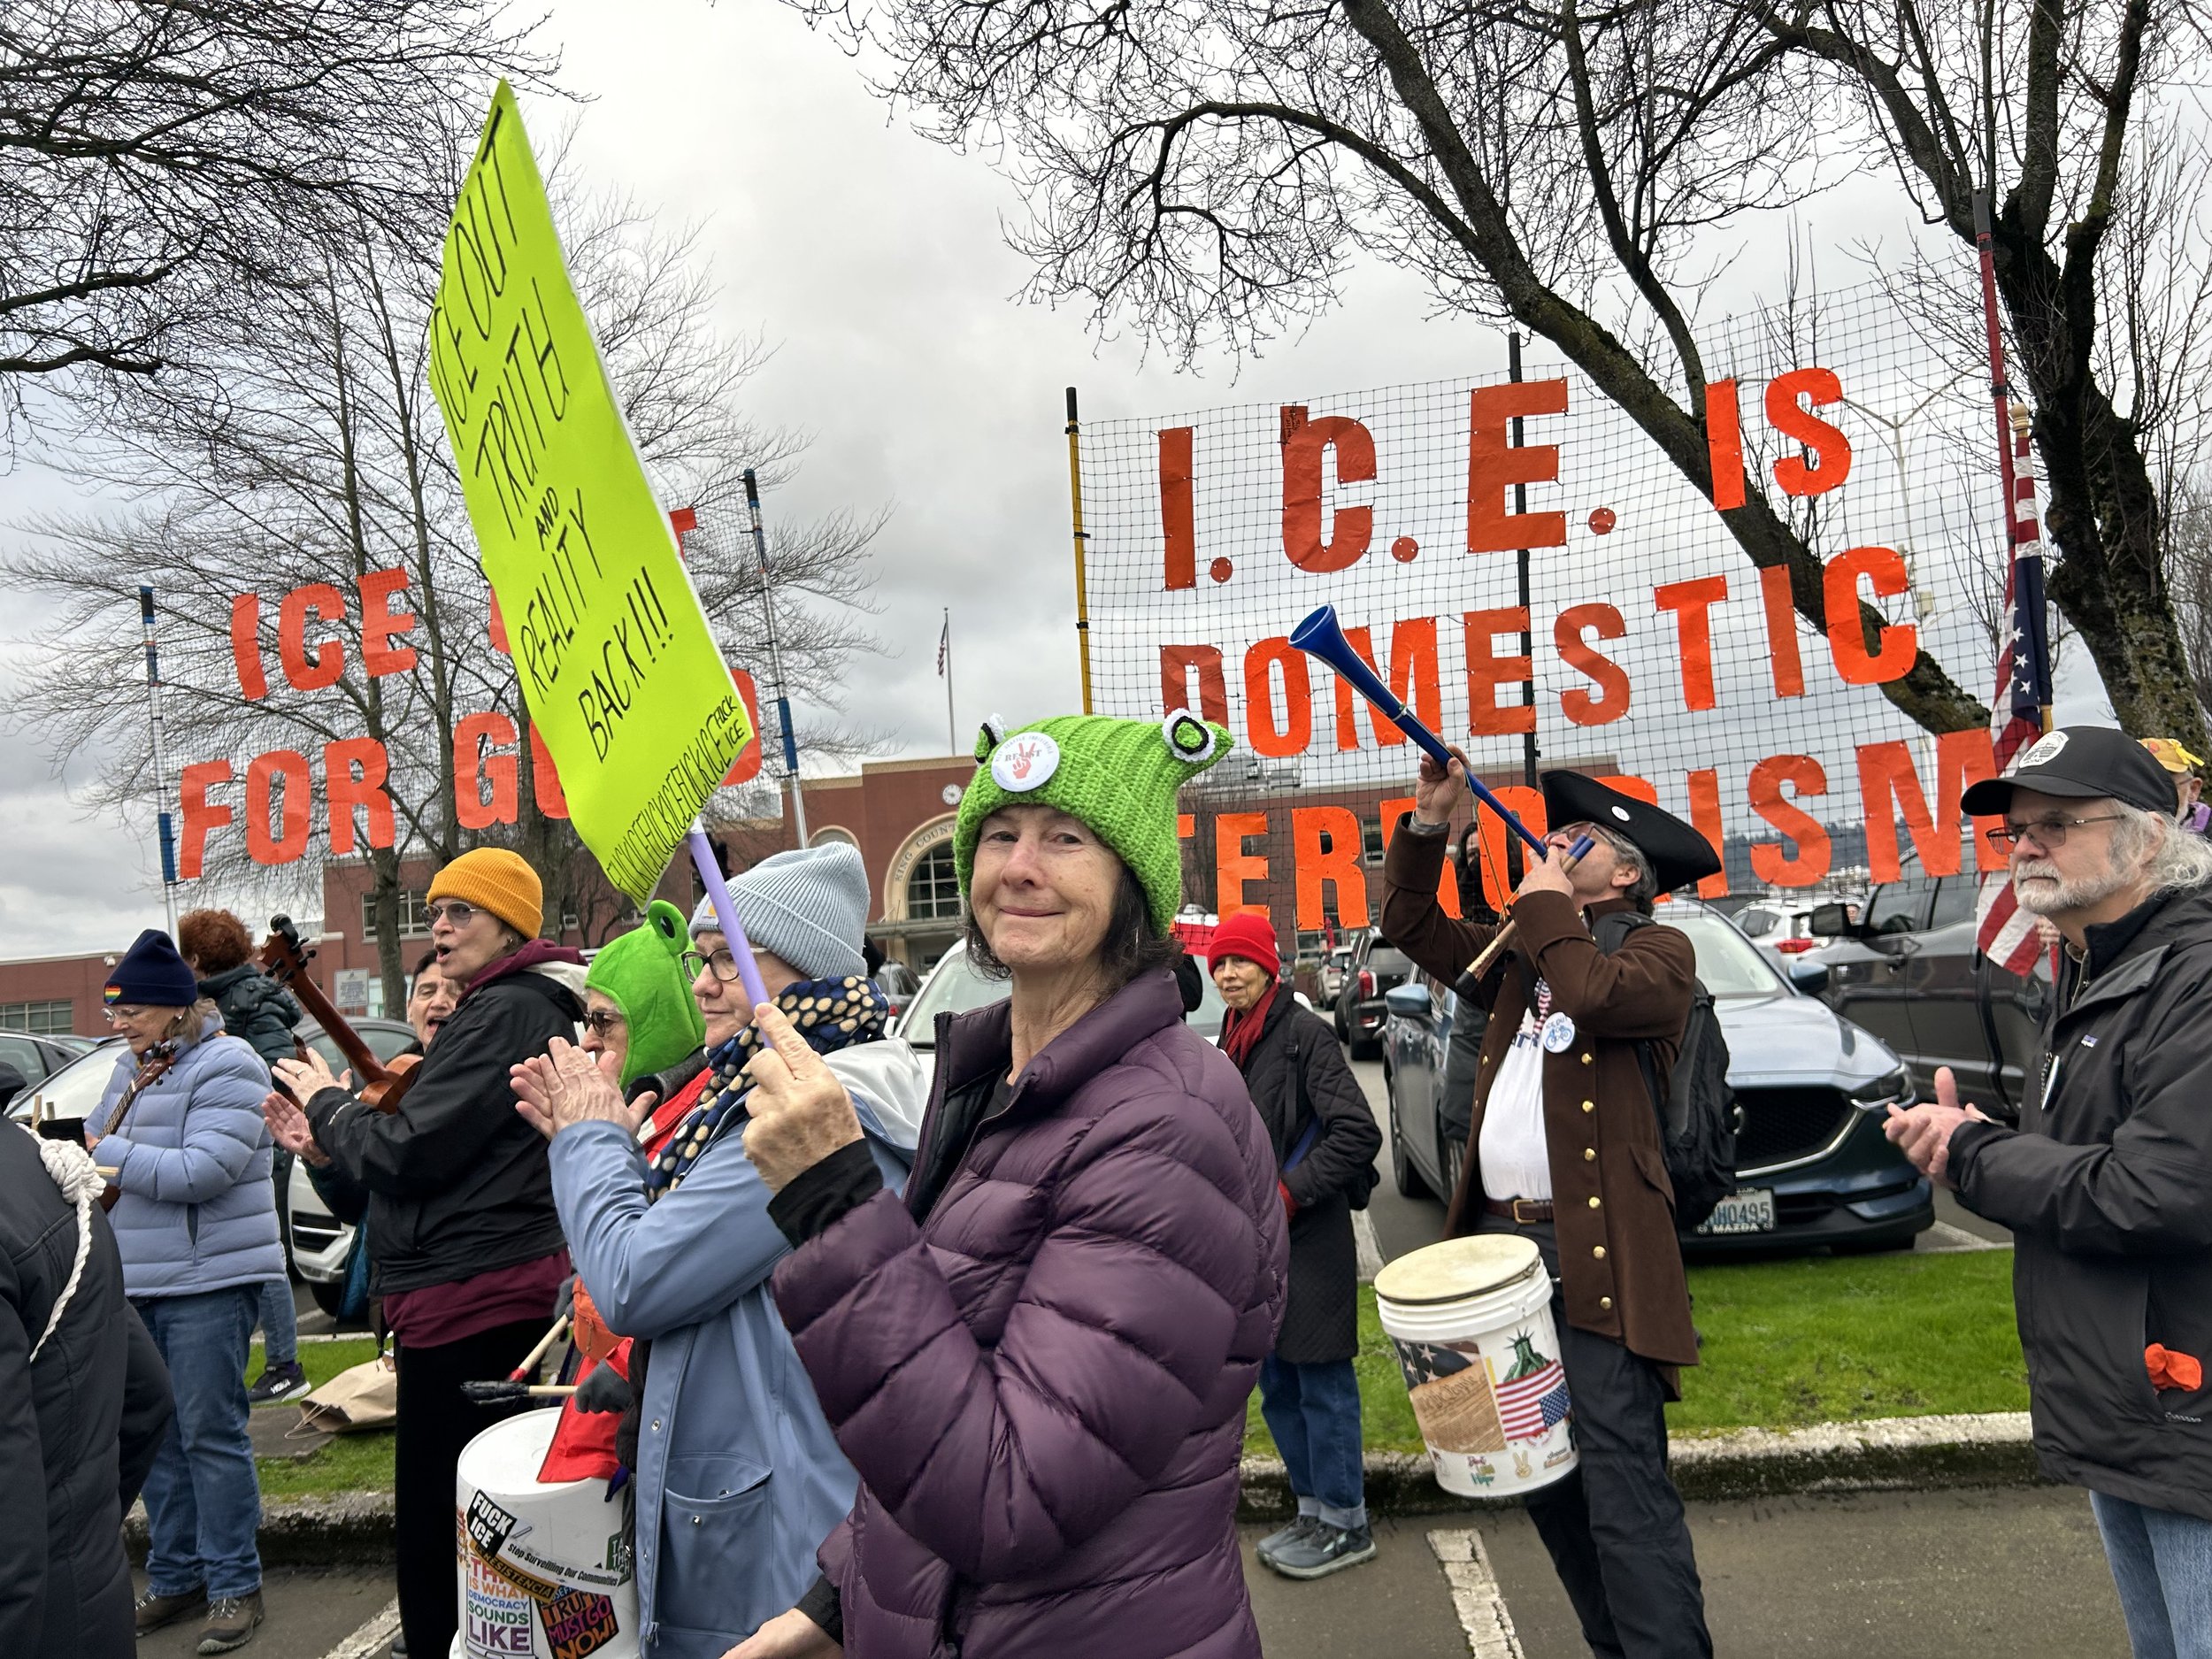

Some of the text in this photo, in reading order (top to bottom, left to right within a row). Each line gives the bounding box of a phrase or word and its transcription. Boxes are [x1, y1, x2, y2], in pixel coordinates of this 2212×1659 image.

[455, 104, 518, 342] OUT
[475, 277, 570, 540] TRUTH
[1704, 367, 1852, 511] IS
[535, 487, 559, 552] AND
[520, 488, 603, 705] REALITY
[230, 566, 417, 701] ICE
[1159, 546, 1917, 757] DOMESTIC
[578, 566, 675, 764] BACK!!!
[714, 695, 738, 730] FUCK
[725, 718, 745, 749] ICE
[180, 737, 396, 879] FOR
[1169, 726, 2009, 932] EROISM
[895, 822, 956, 882] KING COUNT
[1712, 1223, 1760, 1233] MAZDA
[470, 1516, 495, 1548] ICE
[472, 1493, 514, 1536] FUCK
[469, 1576, 480, 1591] IS
[483, 1553, 553, 1598] RESISTENCIA
[507, 1543, 525, 1558] Stop
[565, 1566, 579, 1579] Our
[468, 1589, 529, 1610] DEMOCRACY
[468, 1601, 529, 1625] SOUNDS
[541, 1591, 601, 1625] TRUM
[548, 1595, 611, 1646] MUST GO
[468, 1615, 530, 1652] LIKE
